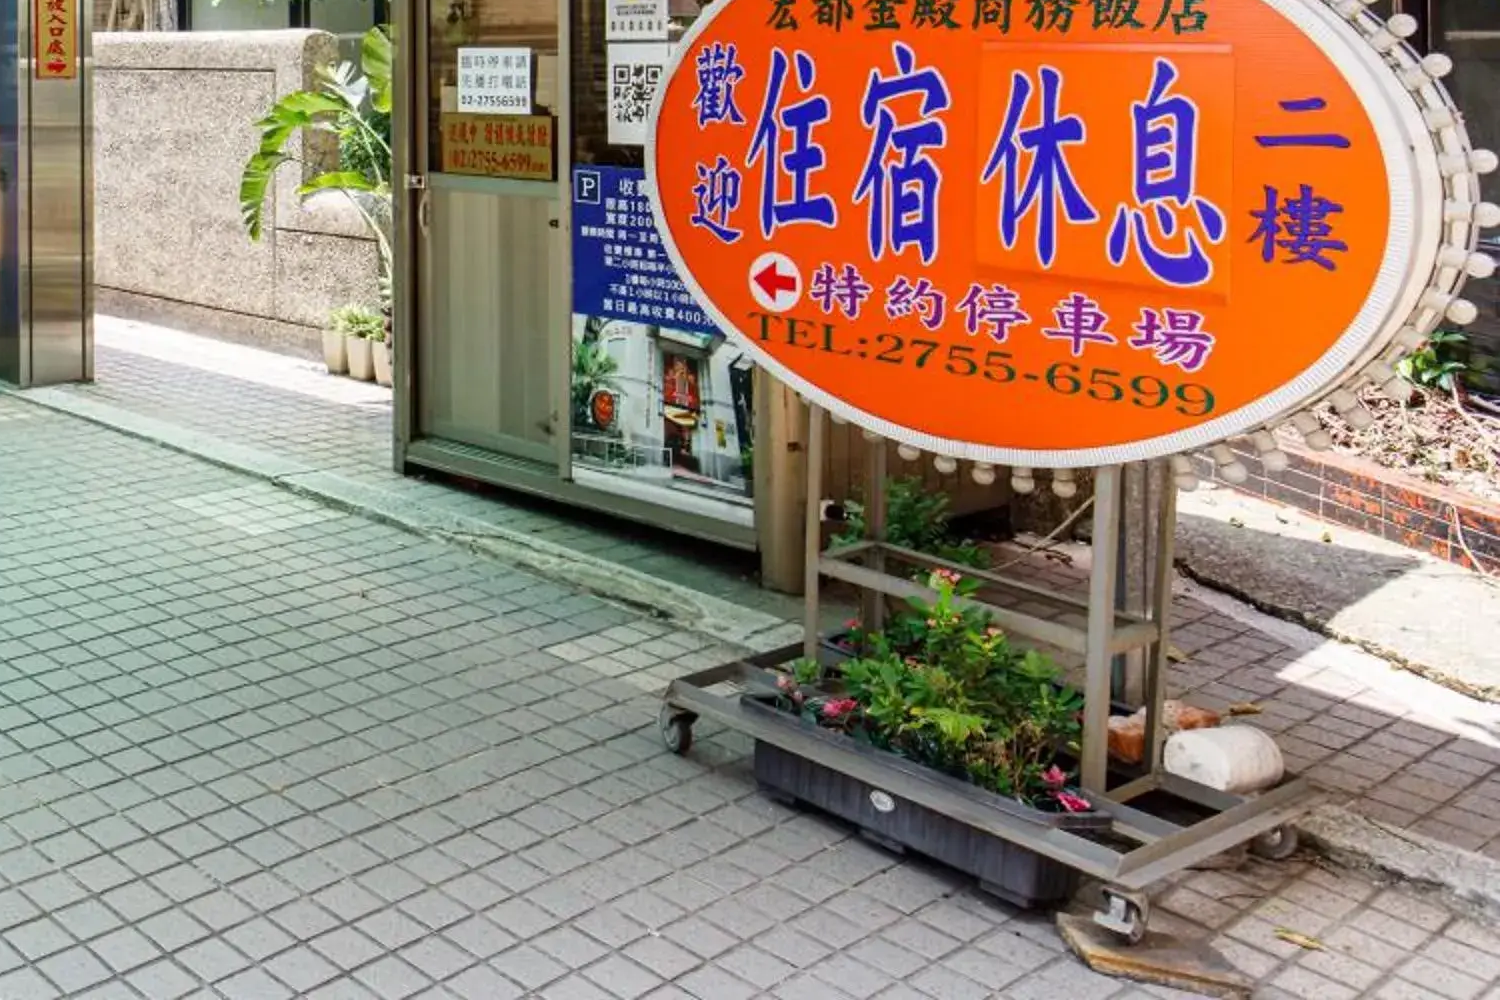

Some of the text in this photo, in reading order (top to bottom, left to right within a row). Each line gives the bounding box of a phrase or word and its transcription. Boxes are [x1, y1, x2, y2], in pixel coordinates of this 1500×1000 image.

[460, 95, 528, 107] 02-27556599
[690, 41, 745, 245] 歡迎
[581, 177, 596, 197] P
[745, 41, 1226, 288] 住宿休息
[1247, 96, 1352, 273] 二樓
[747, 310, 1218, 418] TEL:2755-6599
[810, 264, 1218, 372] 特約停車場
